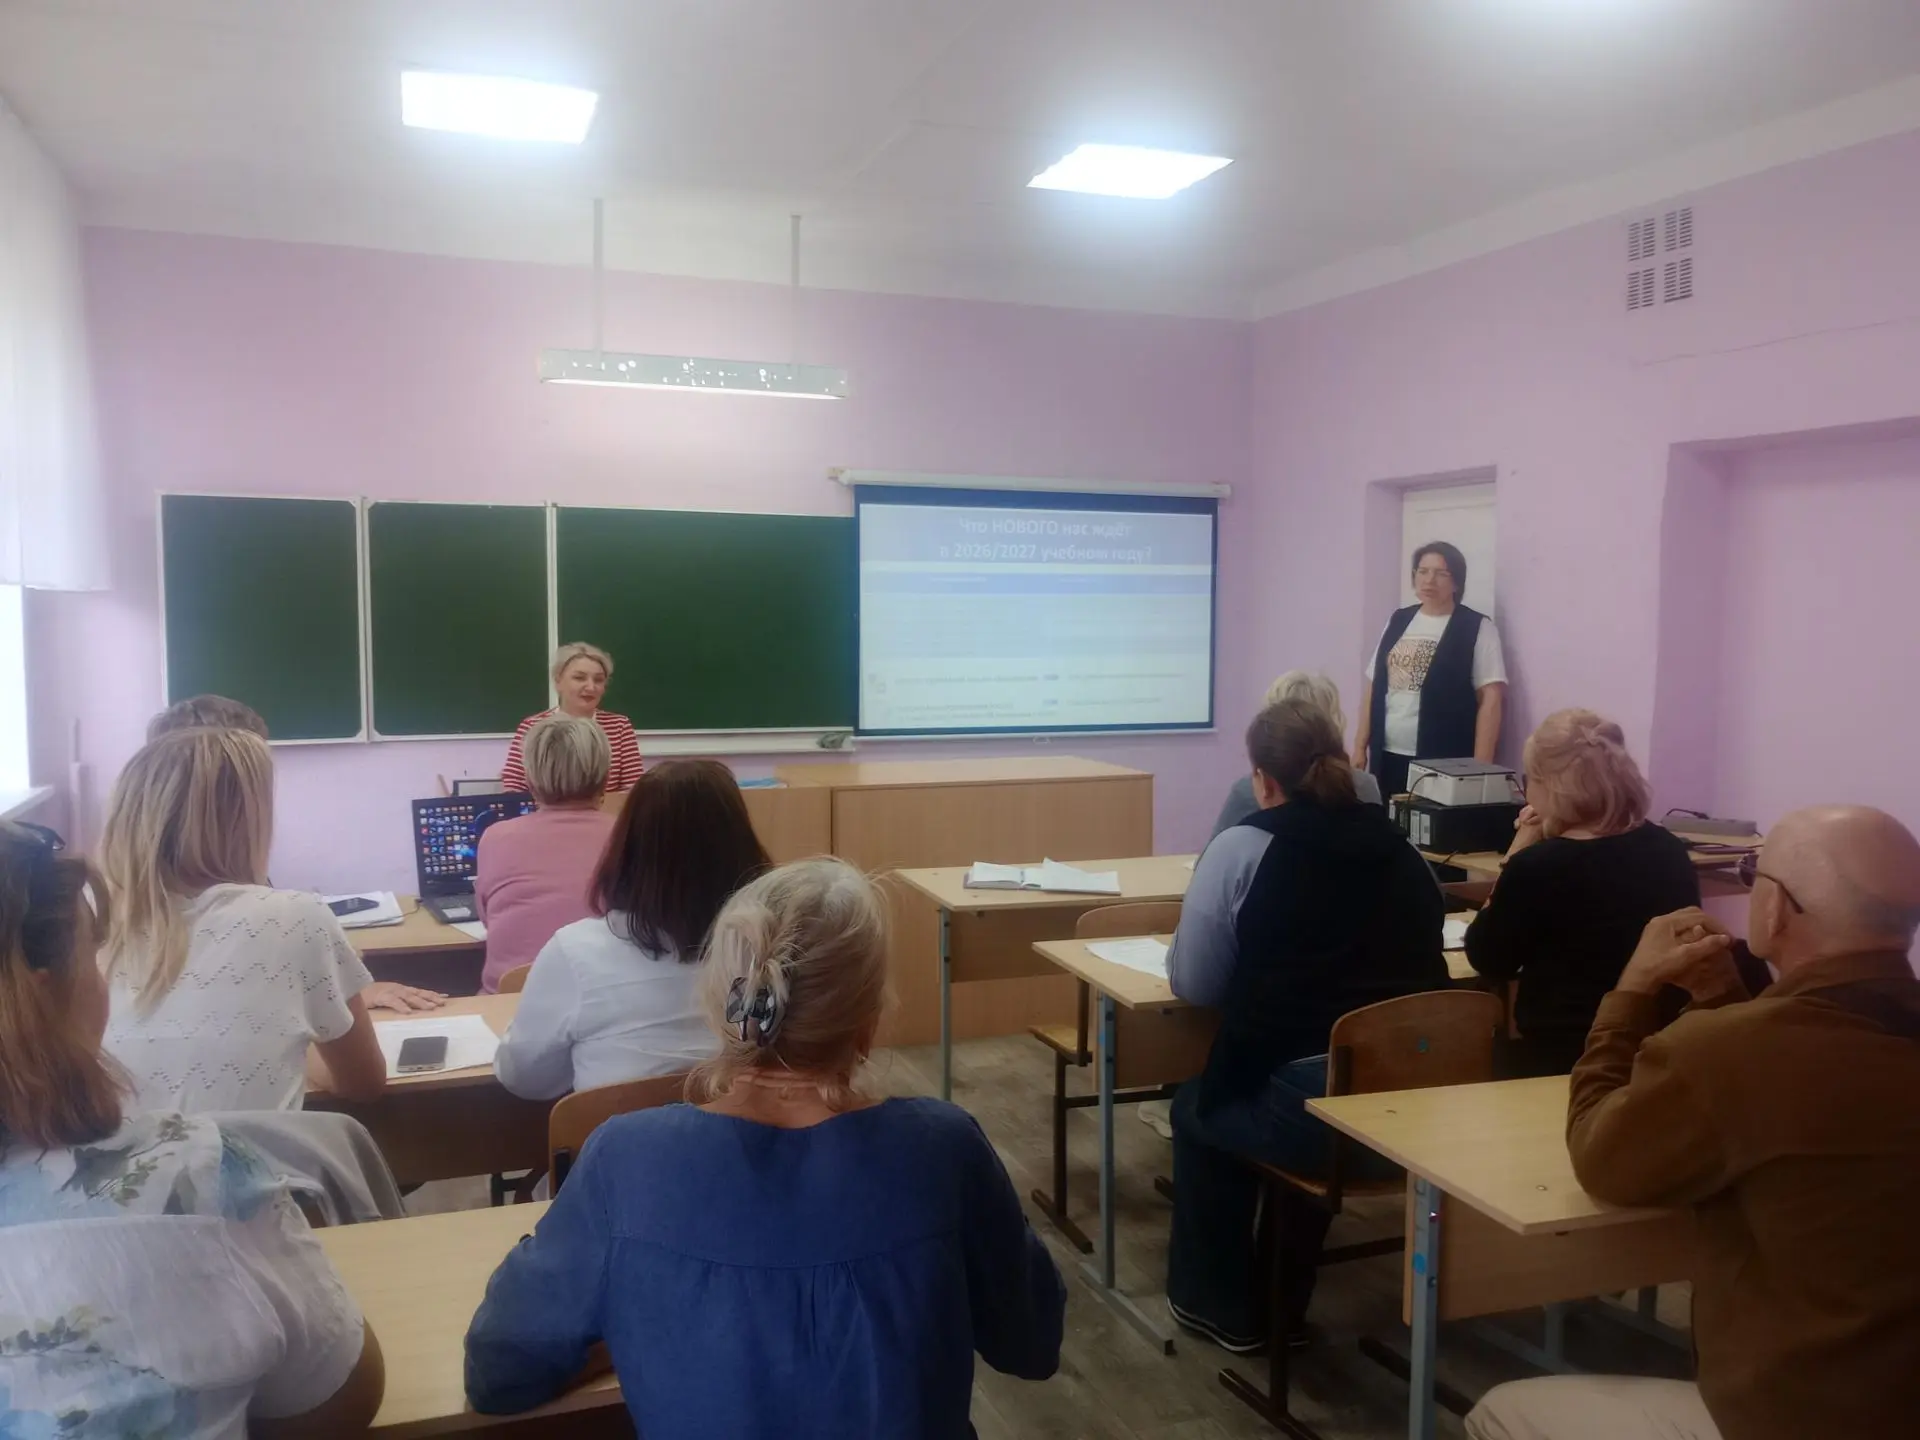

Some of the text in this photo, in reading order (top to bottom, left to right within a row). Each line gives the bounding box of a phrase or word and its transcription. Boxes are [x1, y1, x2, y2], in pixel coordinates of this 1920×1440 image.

[959, 517, 988, 534] Что
[992, 518, 1058, 536] НОВОГО
[1062, 524, 1089, 537] нас
[954, 542, 1036, 560] 2026/2027
[1041, 544, 1109, 562] учебном
